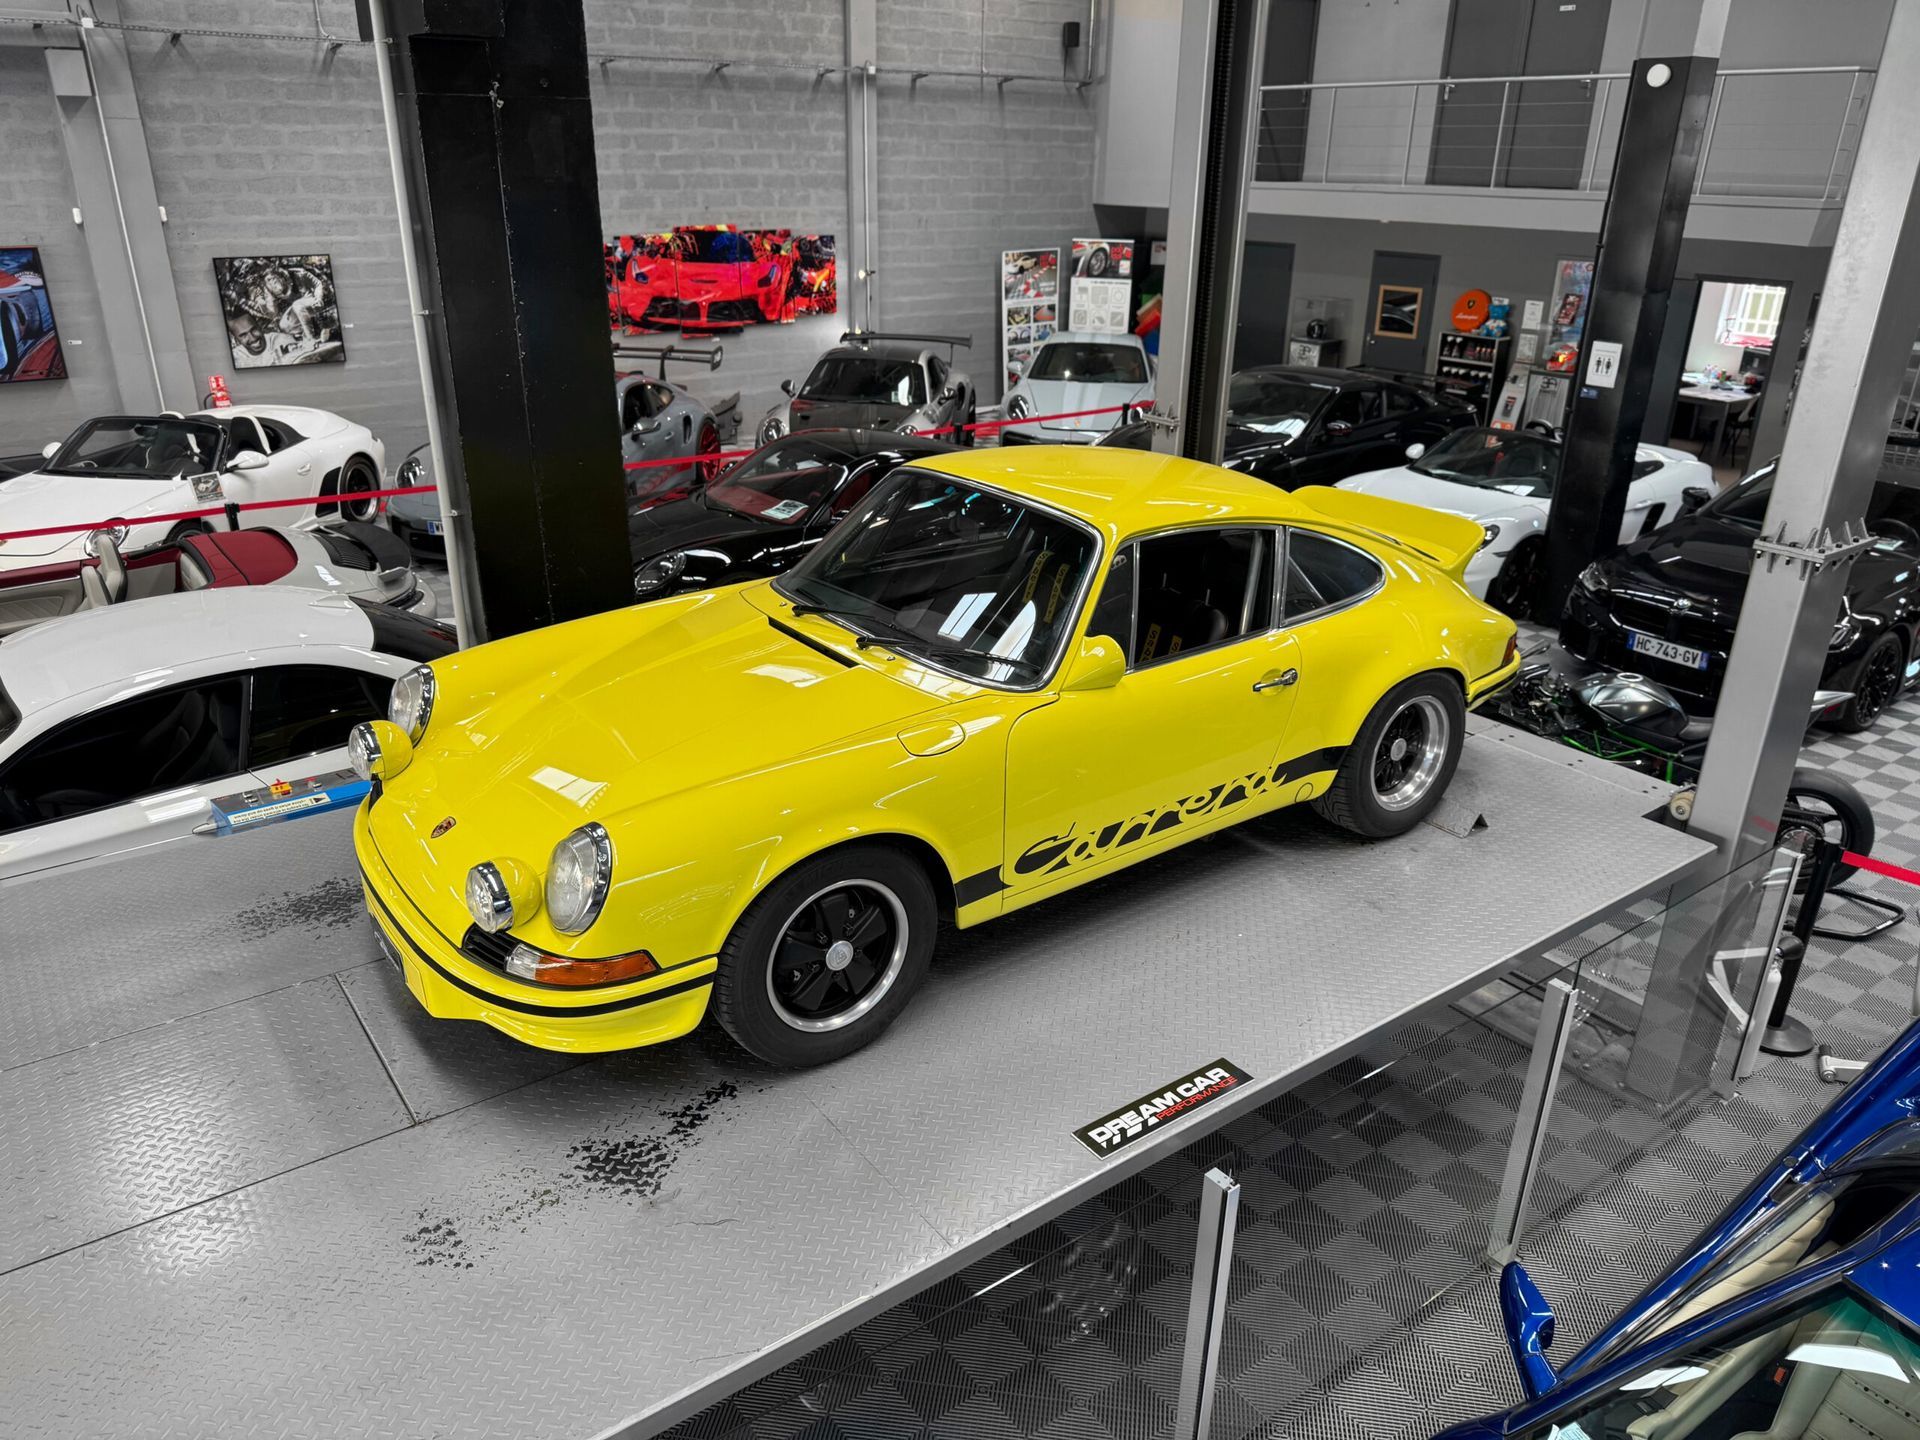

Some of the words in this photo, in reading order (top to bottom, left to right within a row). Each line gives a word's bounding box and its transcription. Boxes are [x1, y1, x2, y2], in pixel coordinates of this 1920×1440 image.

[1635, 636, 1699, 665] HC-743-GV
[1003, 766, 1287, 885] Carrera
[1087, 1091, 1182, 1144] DREAM
[1176, 1067, 1231, 1097] CAR
[1156, 1075, 1238, 1120] PERFORMANCE
